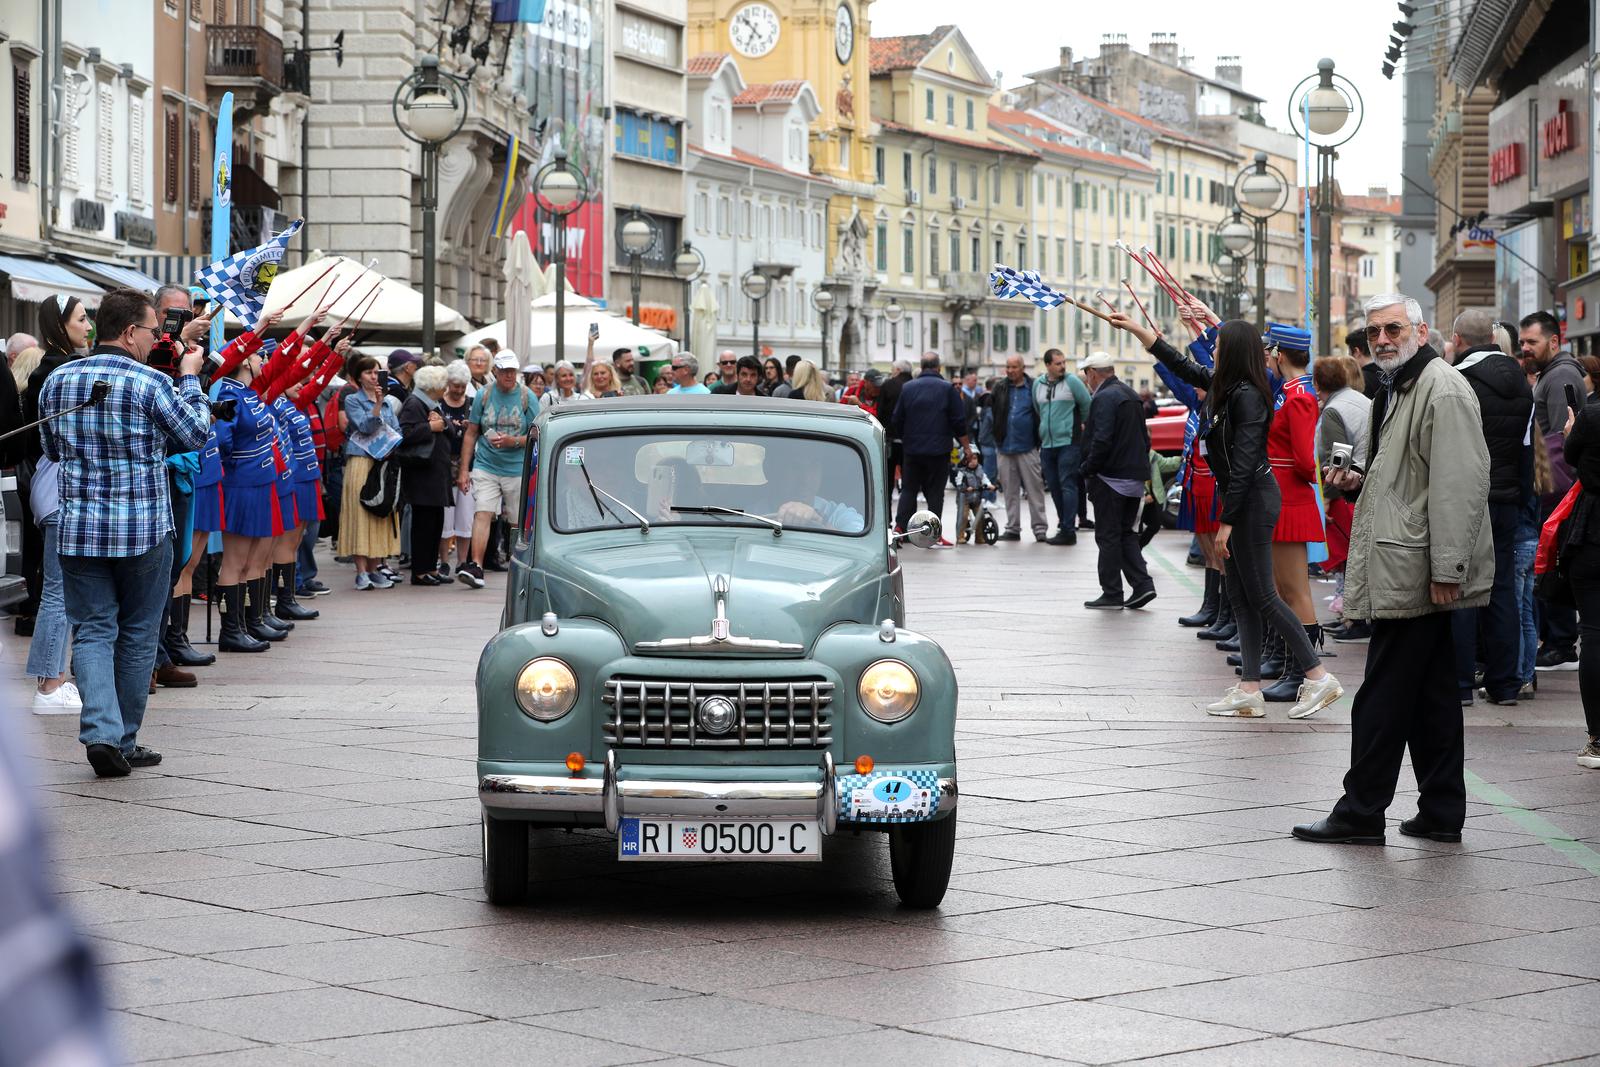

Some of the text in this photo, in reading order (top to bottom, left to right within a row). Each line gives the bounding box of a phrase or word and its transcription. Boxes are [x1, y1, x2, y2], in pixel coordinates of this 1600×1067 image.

[882, 781, 902, 793] 47
[642, 823, 807, 854] RI 0500-C
[623, 842, 637, 851] HR
